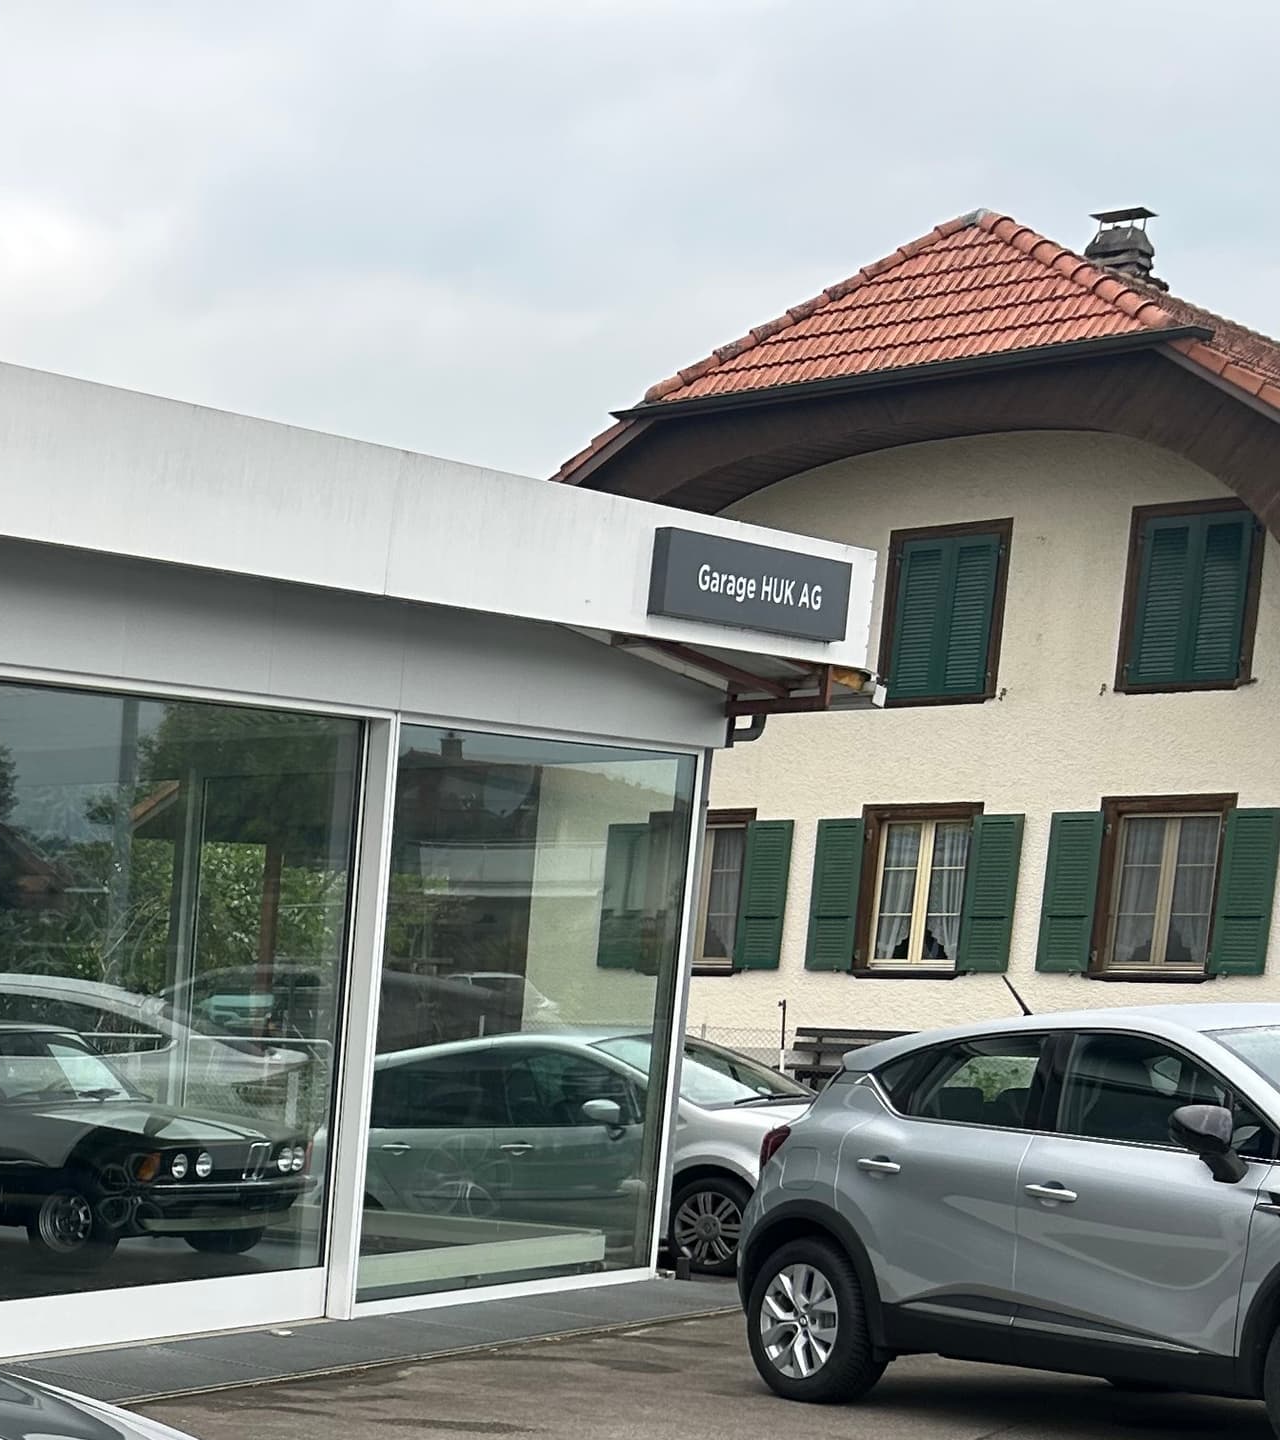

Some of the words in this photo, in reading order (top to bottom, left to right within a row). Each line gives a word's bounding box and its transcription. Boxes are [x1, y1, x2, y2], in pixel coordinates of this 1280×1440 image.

[697, 563, 757, 603] Garage
[760, 574, 795, 607] HUK
[797, 583, 823, 611] AG
